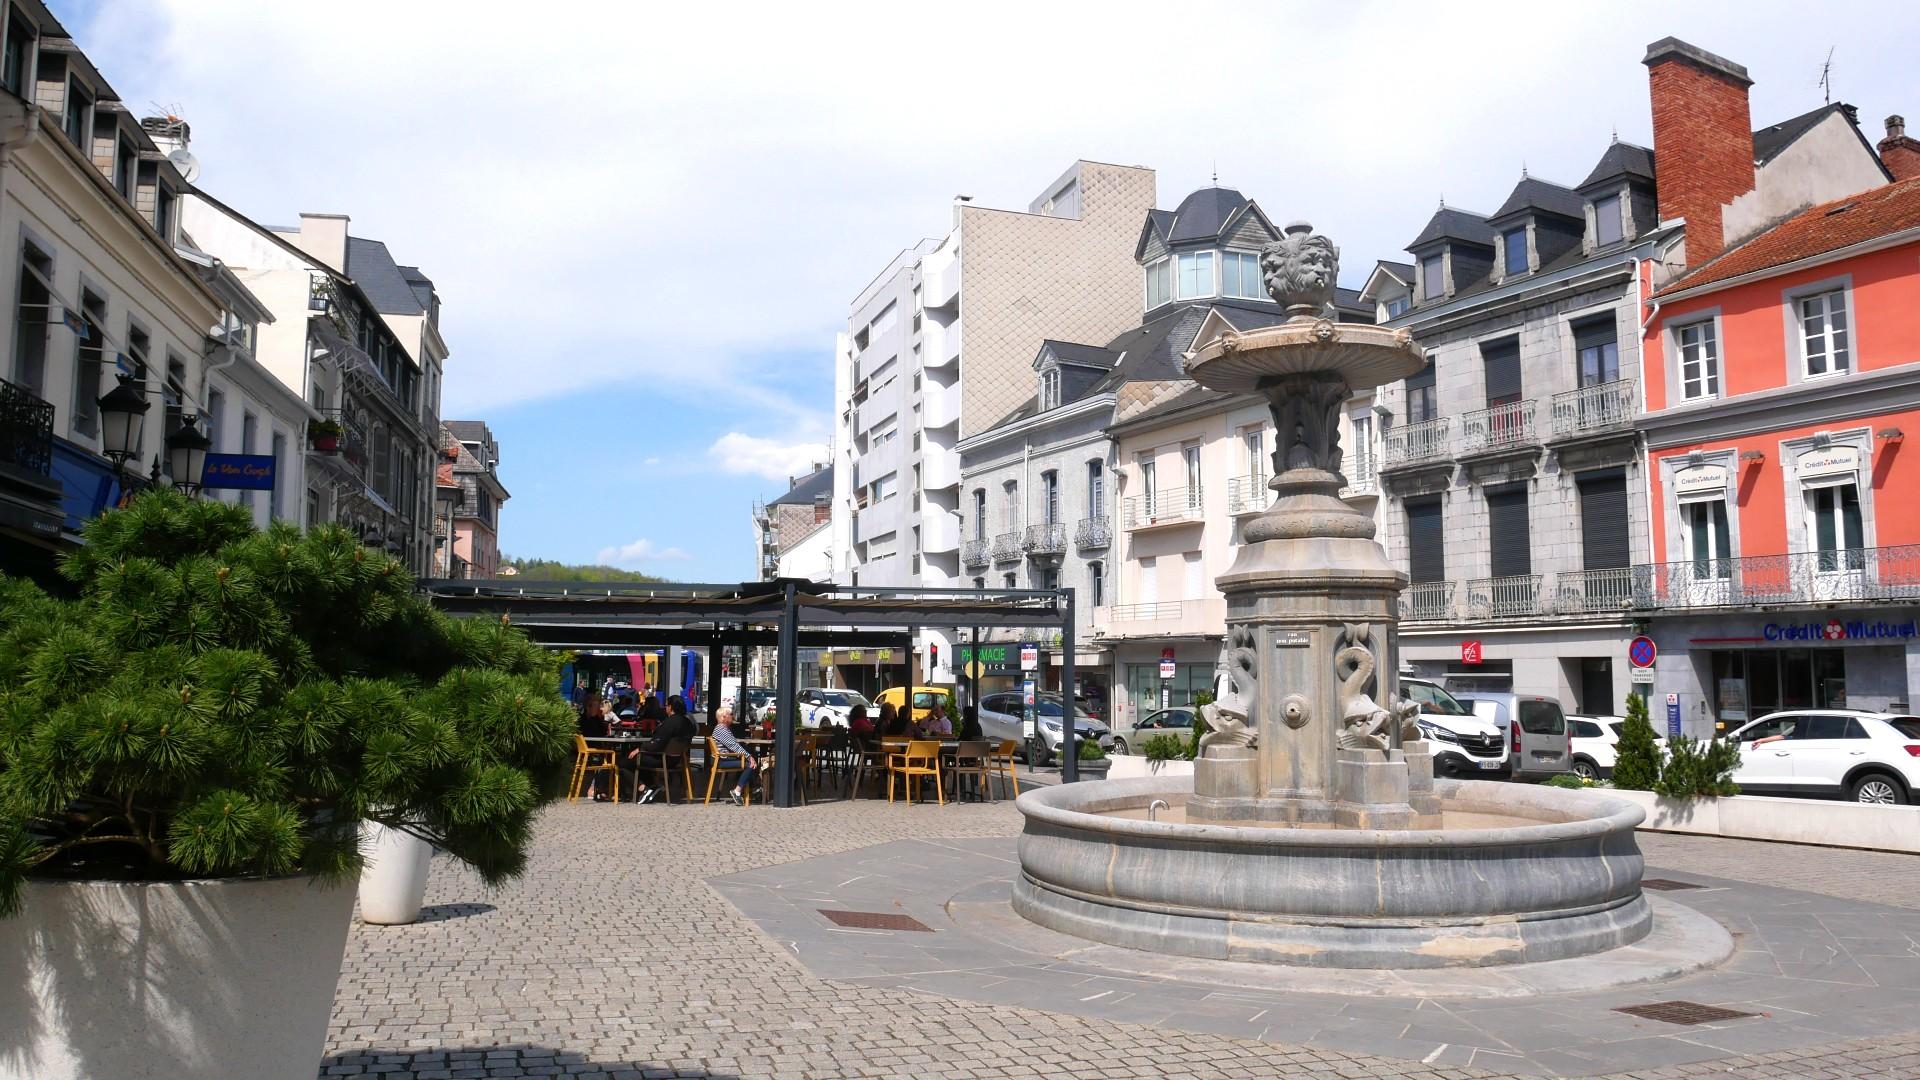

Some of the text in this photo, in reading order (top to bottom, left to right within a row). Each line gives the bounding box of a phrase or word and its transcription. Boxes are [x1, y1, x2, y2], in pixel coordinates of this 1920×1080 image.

[1830, 457, 1852, 465] Mutuel
[1763, 618, 1917, 641] Crédit Mutuel
[962, 648, 1006, 660] PHMACIE
